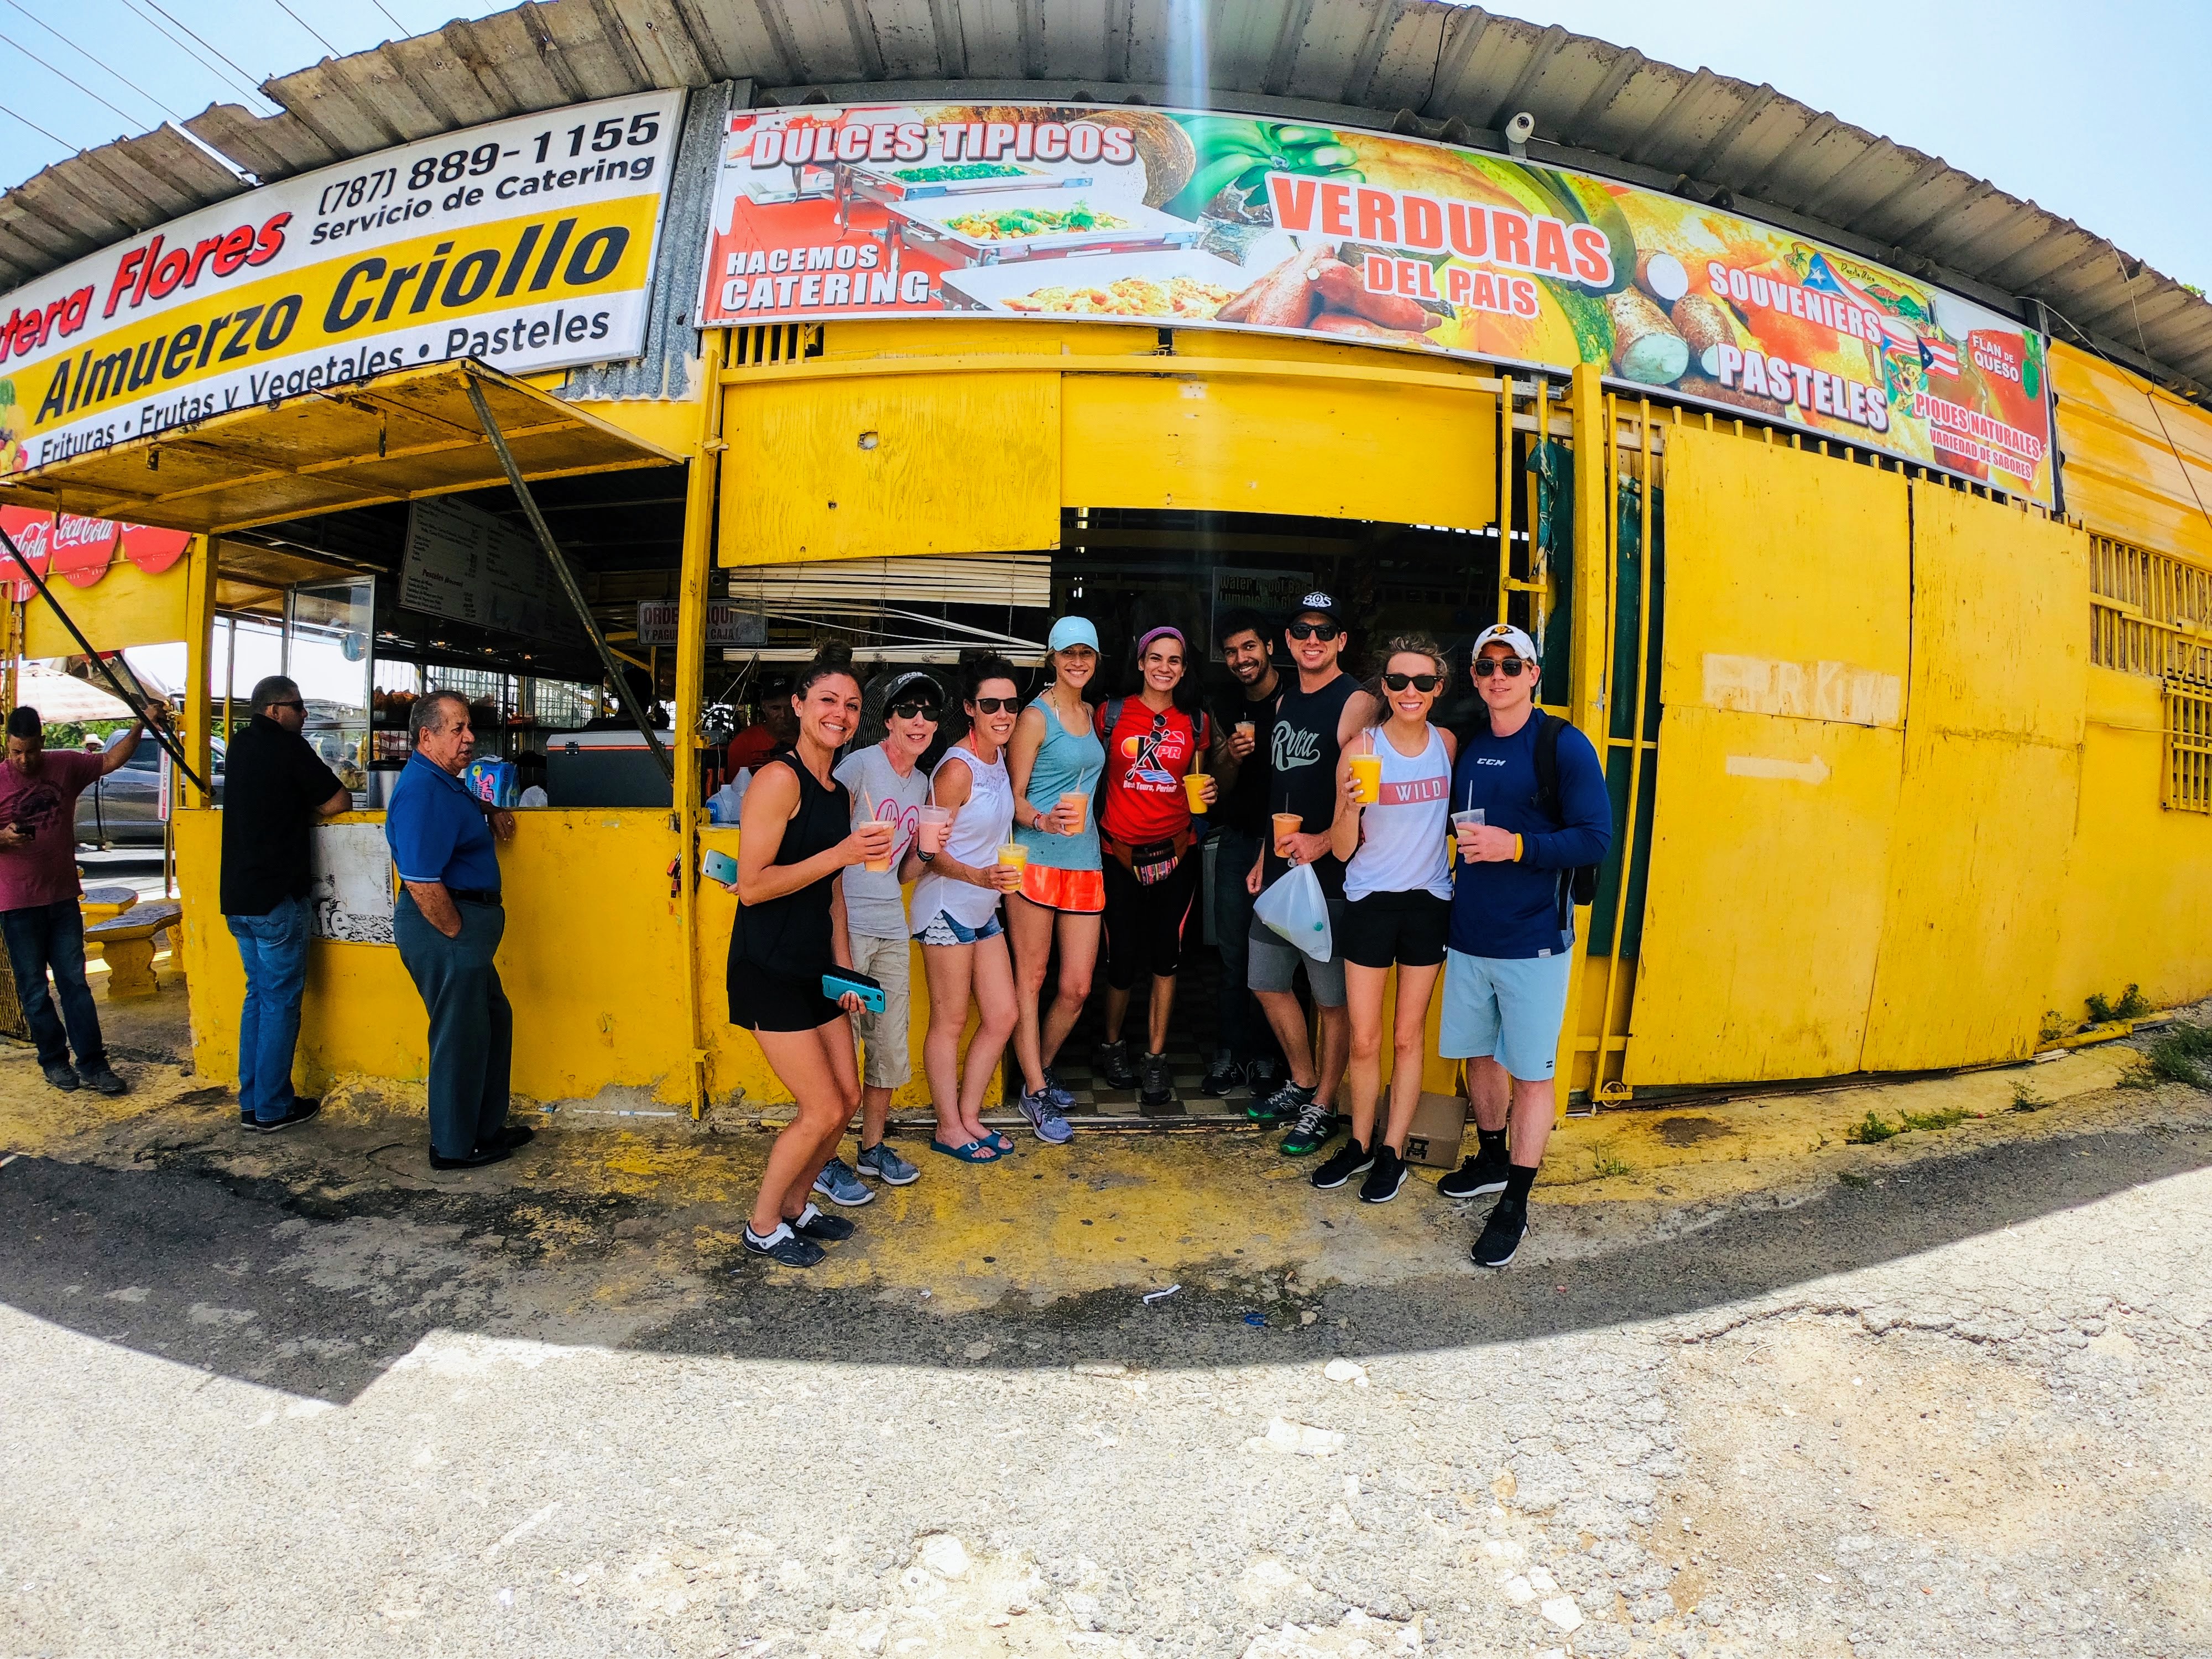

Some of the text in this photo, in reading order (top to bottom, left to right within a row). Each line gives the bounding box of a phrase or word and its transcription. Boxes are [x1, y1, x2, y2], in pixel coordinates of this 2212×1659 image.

[319, 111, 661, 216] (787) 889-1155
[750, 121, 1137, 168] DULCES TIPICOS
[310, 155, 655, 246] Servicio de Catering
[1269, 175, 1611, 284] VERDURAS
[727, 244, 879, 276] HACEMOS
[1841, 263, 1875, 282] Puerto Rico
[0, 212, 294, 364] tera Flores
[722, 270, 930, 311] CATERING
[1368, 255, 1539, 316] DEL PAIS
[1708, 261, 1881, 344] SOUVENIERS
[34, 218, 630, 426] Almuerzo Criollo
[1972, 335, 2015, 364] FLAN DE
[1974, 351, 2020, 383] QUESO
[40, 423, 115, 464] Frituras
[140, 390, 214, 434] Frutas
[251, 346, 404, 404] Vegetales
[445, 309, 611, 358] Pasteles
[1717, 342, 1890, 433] PASTELES
[1914, 393, 2041, 459] PIQUES NATURALES
[1929, 429, 2032, 478] VARIEDAD DE SABORES
[644, 607, 679, 625] ORDE
[1302, 592, 1332, 607] 805
[644, 629, 650, 641] Y
[711, 628, 735, 641] CAJA
[1157, 745, 1182, 759] PR
[1477, 758, 1506, 766] CCM
[1123, 780, 1177, 792] Best Tours, Period!
[1395, 780, 1442, 802] WILD
